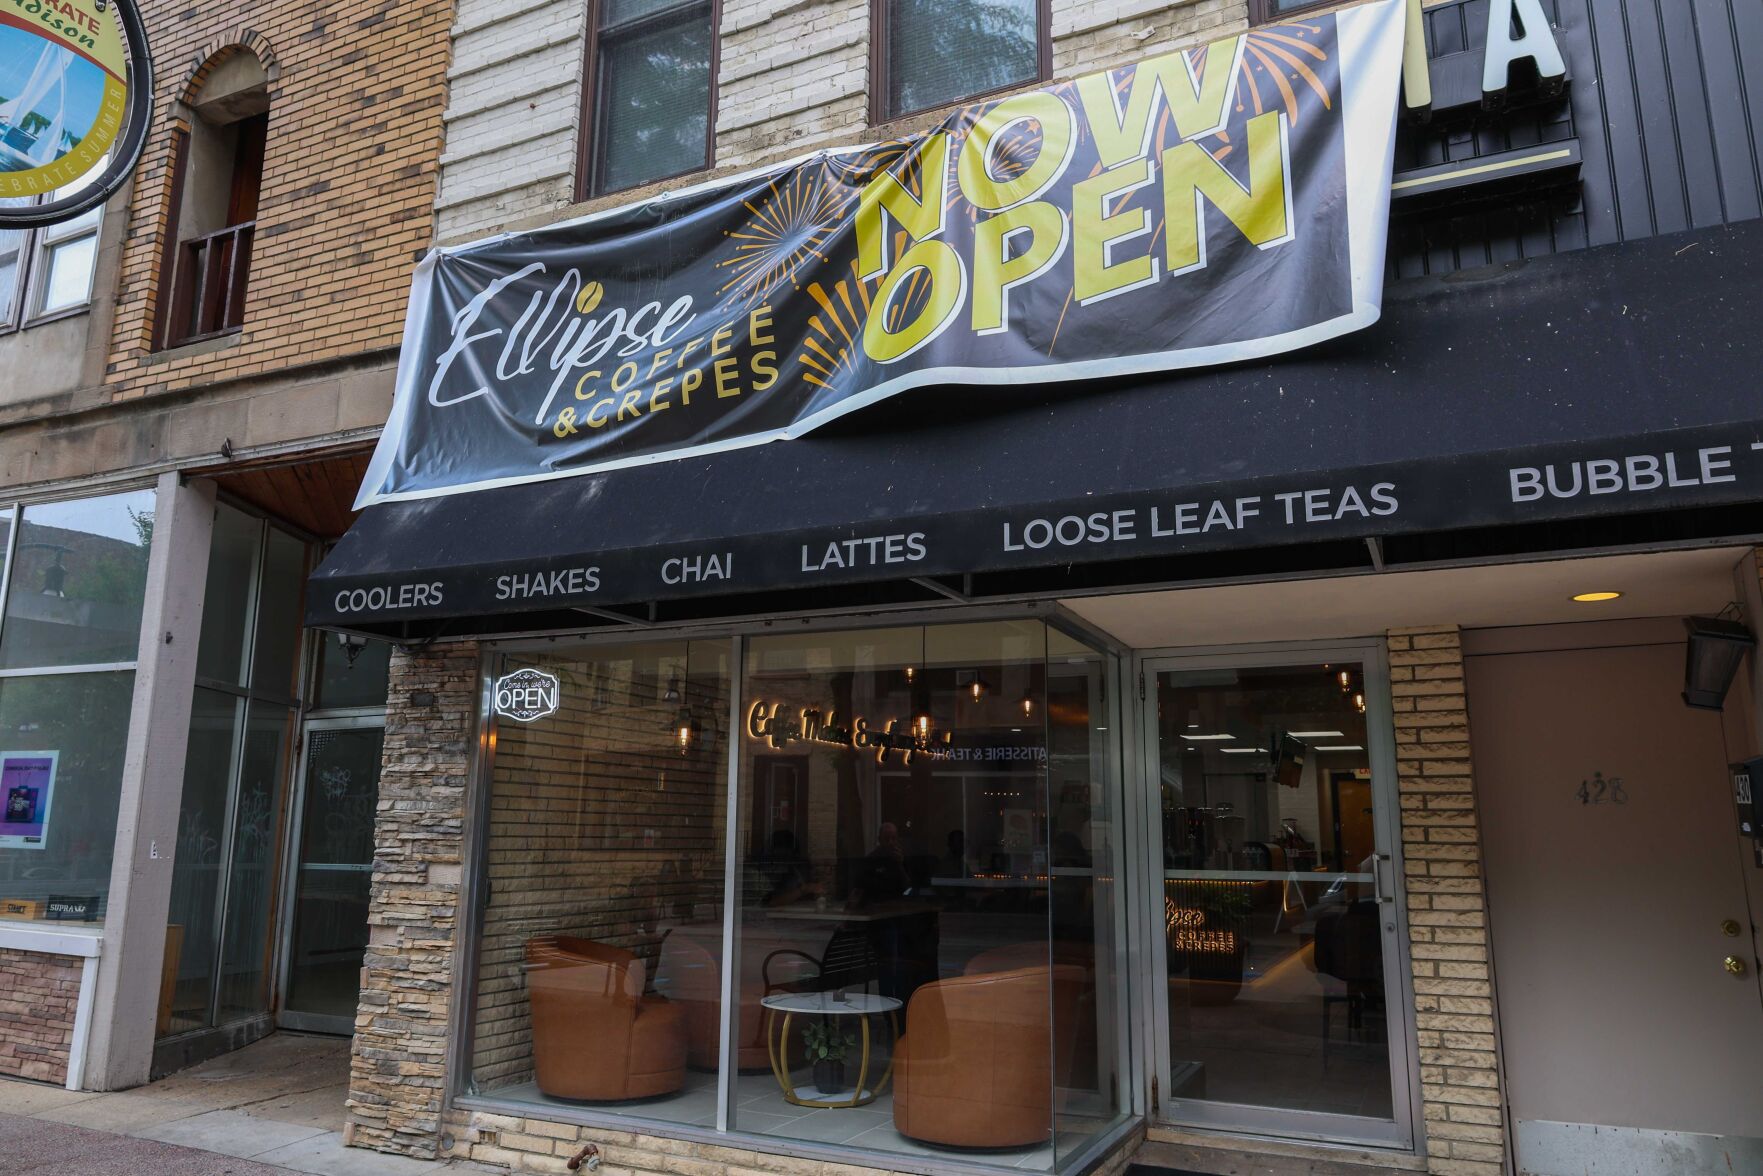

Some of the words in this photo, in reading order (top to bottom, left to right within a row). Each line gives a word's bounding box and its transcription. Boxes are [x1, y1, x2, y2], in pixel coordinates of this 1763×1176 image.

[80, 88, 121, 163] SUMMER
[855, 34, 1247, 281] NOW
[863, 110, 1295, 364] OPEN
[429, 262, 698, 425] Ellipse
[574, 305, 775, 401] COFFEE
[334, 581, 444, 613] COOLERS
[495, 566, 601, 600] SHAKES
[661, 553, 733, 585] CHAI
[801, 532, 927, 572] LATTES
[1003, 508, 1137, 552] LOOSE
[1150, 496, 1261, 537] LEAF
[1274, 482, 1399, 525] TEAS
[1509, 445, 1736, 502] BUBBLE
[497, 688, 554, 709] OPEN
[504, 678, 521, 690] Come
[1178, 930, 1234, 943] COFFEE
